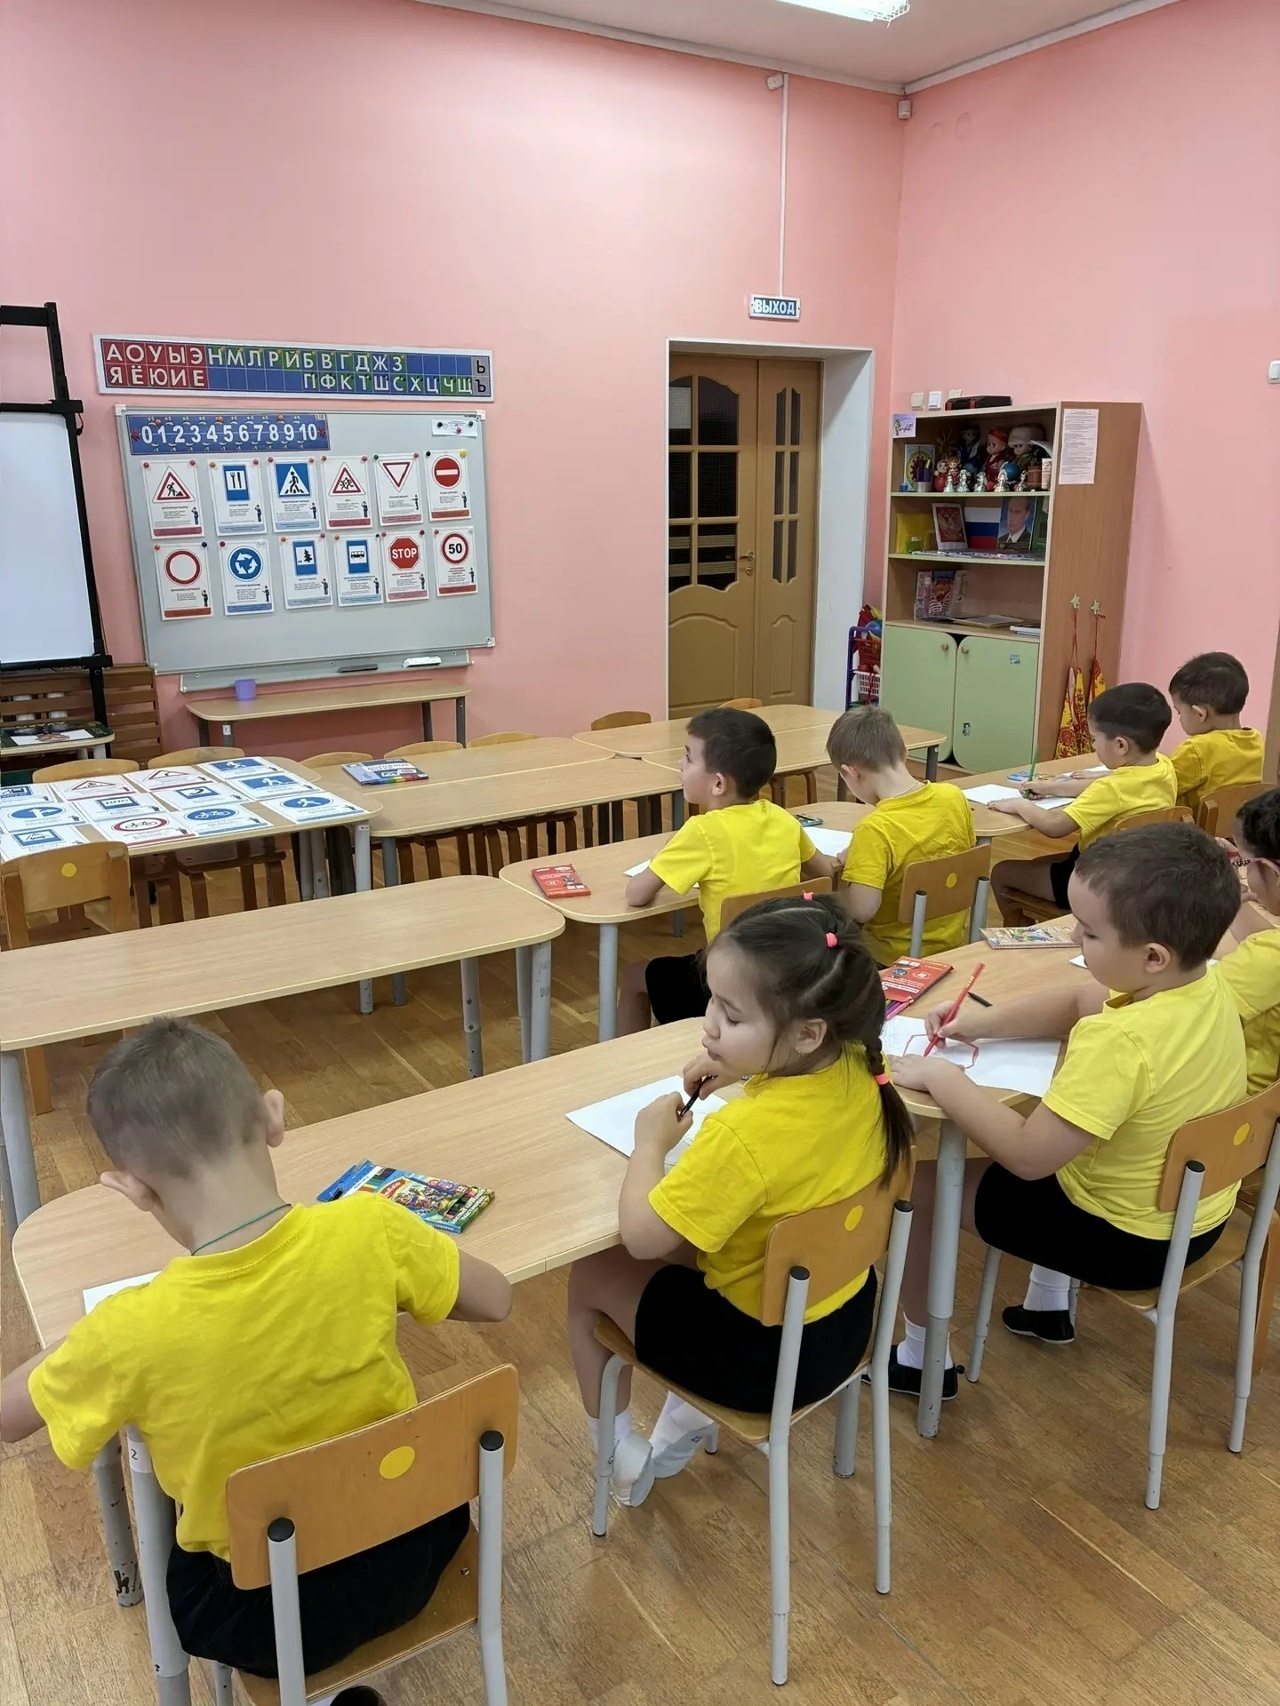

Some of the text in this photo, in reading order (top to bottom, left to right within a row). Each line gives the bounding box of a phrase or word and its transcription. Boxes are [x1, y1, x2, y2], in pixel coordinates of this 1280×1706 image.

[754, 299, 796, 315] ВЫХОД
[141, 423, 317, 444] 0 1 2 3 4 5 6 7 8 9 10
[392, 548, 417, 560] STOP
[448, 543, 462, 555] 50
[130, 1449, 138, 1460] 2
